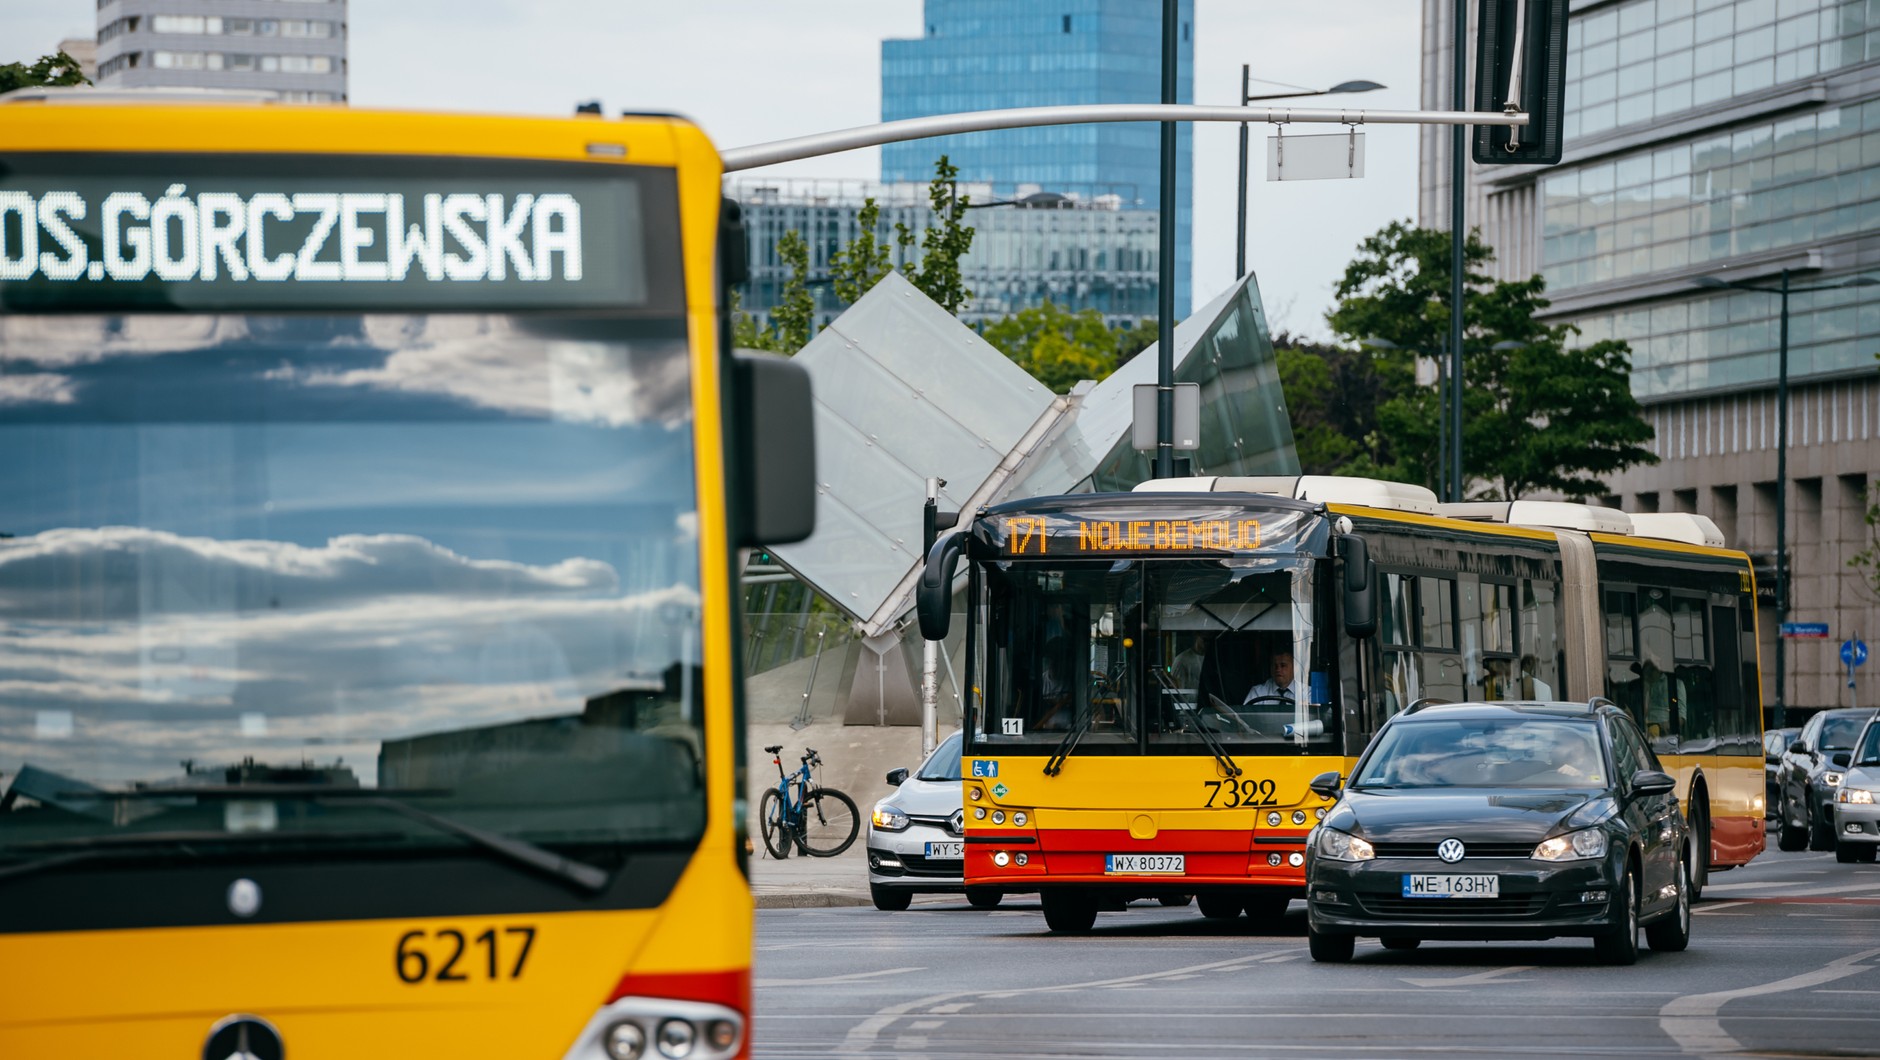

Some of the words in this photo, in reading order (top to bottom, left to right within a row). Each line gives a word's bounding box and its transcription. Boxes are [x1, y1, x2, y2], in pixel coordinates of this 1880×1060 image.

[1006, 518, 1047, 554] 171
[1004, 720, 1019, 733] 11
[1204, 778, 1278, 808] 7322
[933, 844, 949, 855] WY
[1115, 857, 1134, 870] WX
[1139, 857, 1182, 870] 80372
[1413, 877, 1437, 892] WE
[1445, 877, 1495, 892] 163HY
[395, 926, 536, 984] 6217
